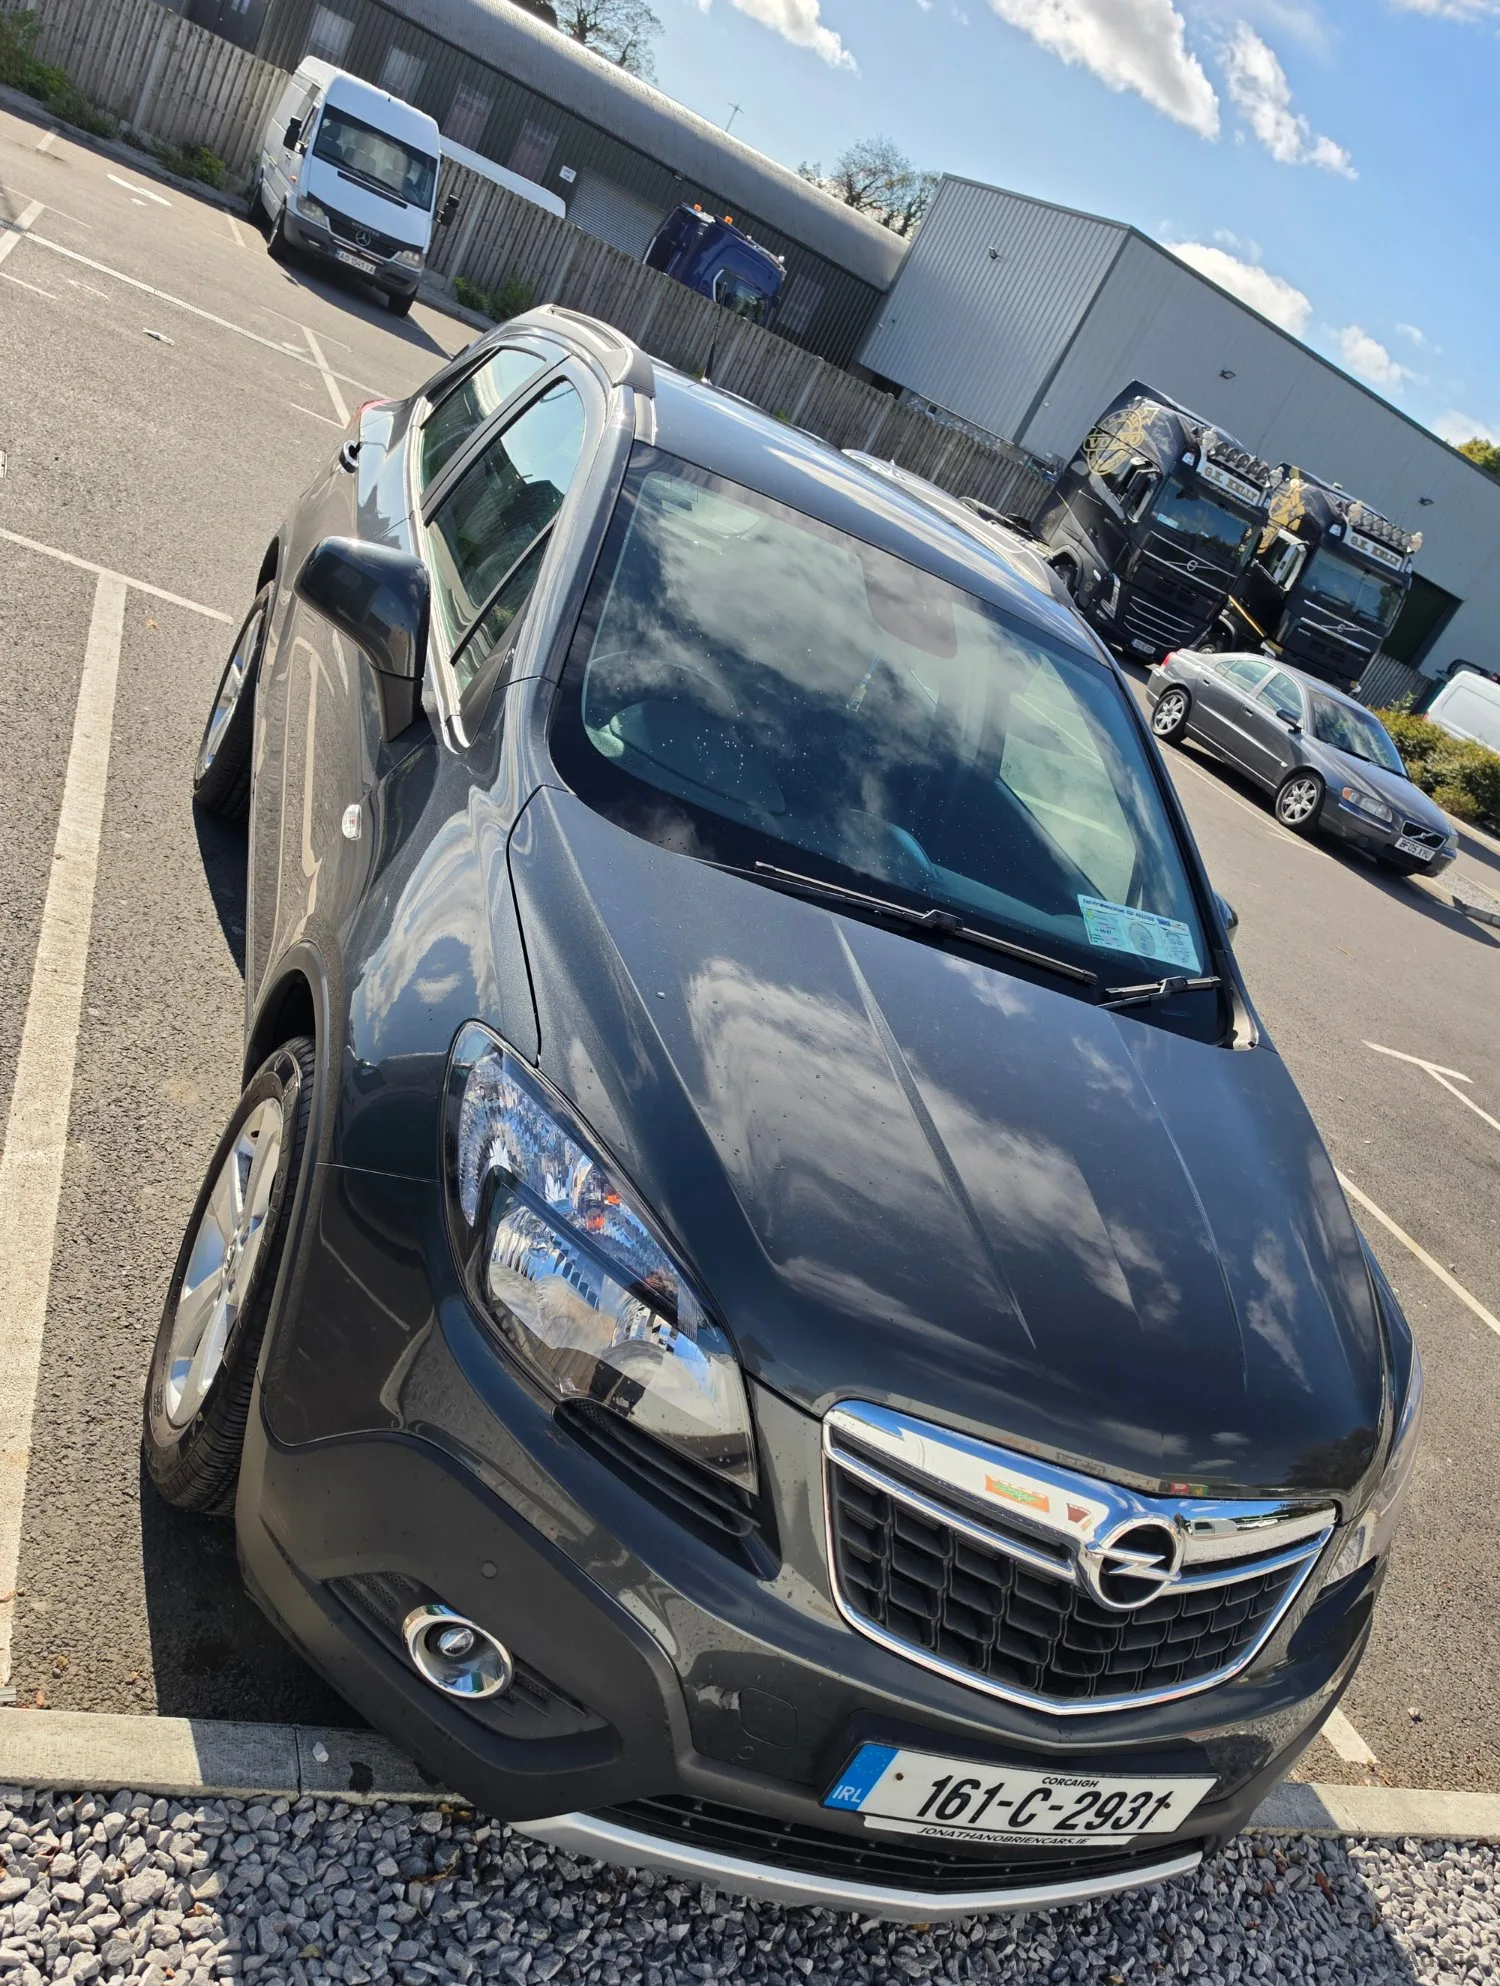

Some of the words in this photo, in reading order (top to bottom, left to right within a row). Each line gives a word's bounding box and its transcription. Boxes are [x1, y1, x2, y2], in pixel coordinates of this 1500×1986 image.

[1226, 477, 1258, 502] KELLY
[1041, 1776, 1100, 1788] CORCAIGH
[831, 1785, 863, 1804] IRL
[916, 1774, 1175, 1833] 161-C-2931
[917, 1827, 1088, 1845] JONATHANOBRIENCARS.IE
